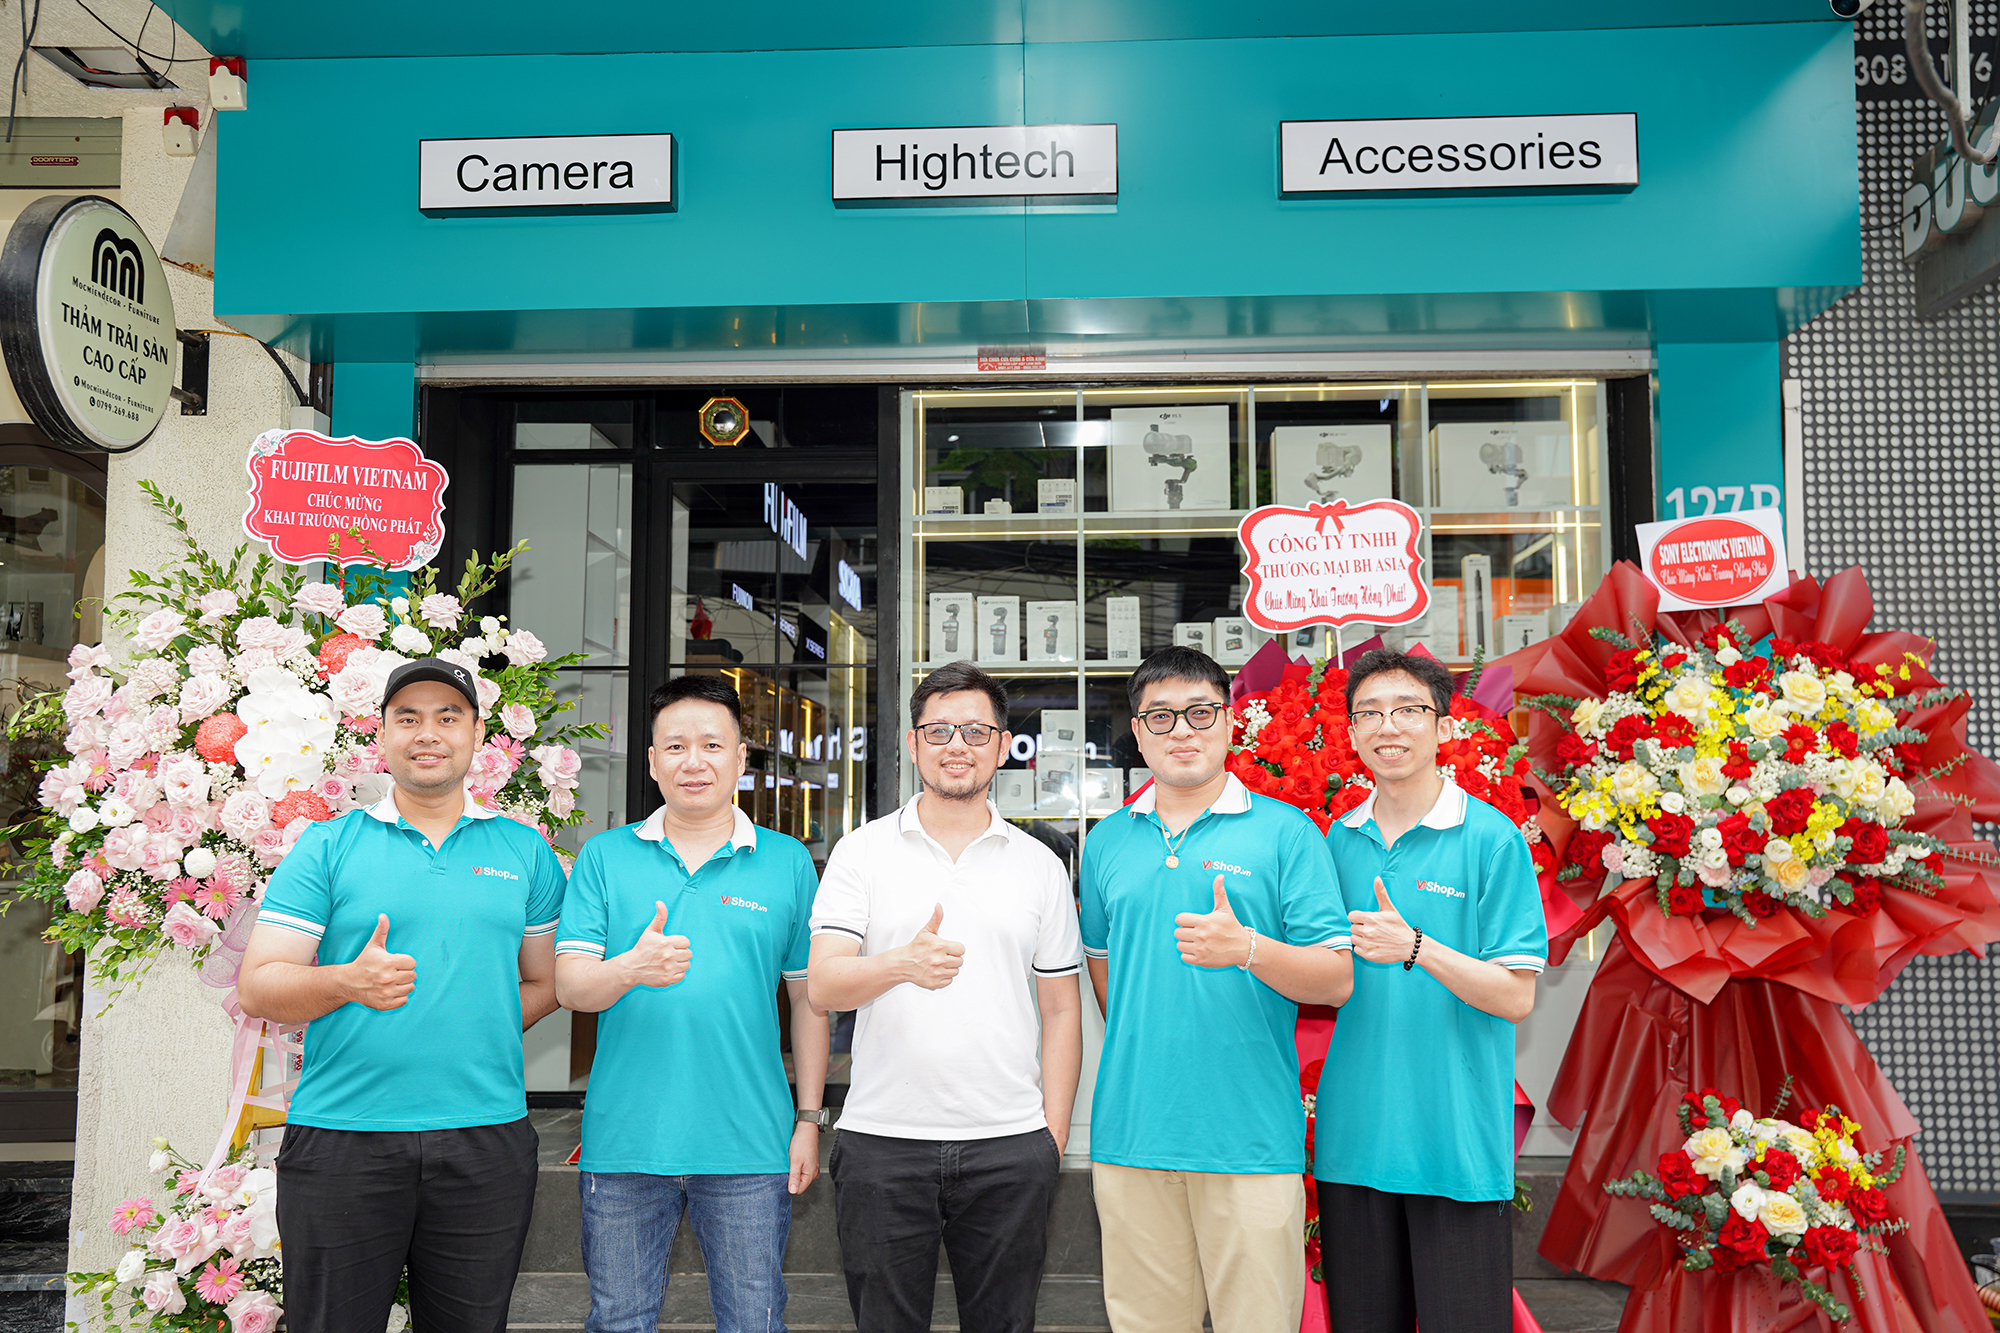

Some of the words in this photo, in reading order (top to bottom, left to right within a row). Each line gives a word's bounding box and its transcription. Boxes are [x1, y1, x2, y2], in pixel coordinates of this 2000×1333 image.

[1855, 54, 1907, 86] 308
[876, 141, 1074, 191] Hightech
[1319, 132, 1602, 175] Accessories
[456, 154, 634, 193] Camera
[61, 302, 102, 338] THẢM
[107, 323, 138, 353] TRẢI
[143, 336, 168, 365] SÀN
[83, 345, 114, 373] CAO
[118, 357, 147, 385] CẤP
[96, 399, 139, 422] 0799.269.688
[270, 459, 349, 485] FUJIFILM
[353, 465, 428, 491] VIETNAM
[307, 491, 342, 509] CHÚC
[344, 493, 382, 512] MỪNG
[263, 509, 295, 525] KHAI
[390, 517, 423, 535] PHÁT
[1268, 533, 1318, 554] CÔNG
[1321, 535, 1344, 550] TY
[1349, 531, 1397, 549] TNHH
[1659, 543, 1680, 565] SONY
[1680, 538, 1730, 563] ELECTRONICS
[1729, 535, 1766, 559] VIETNAM
[1261, 560, 1320, 579] THƯƠNG
[1323, 559, 1350, 578] MẠI
[1353, 559, 1372, 574] BH
[1375, 556, 1407, 572] ASIA
